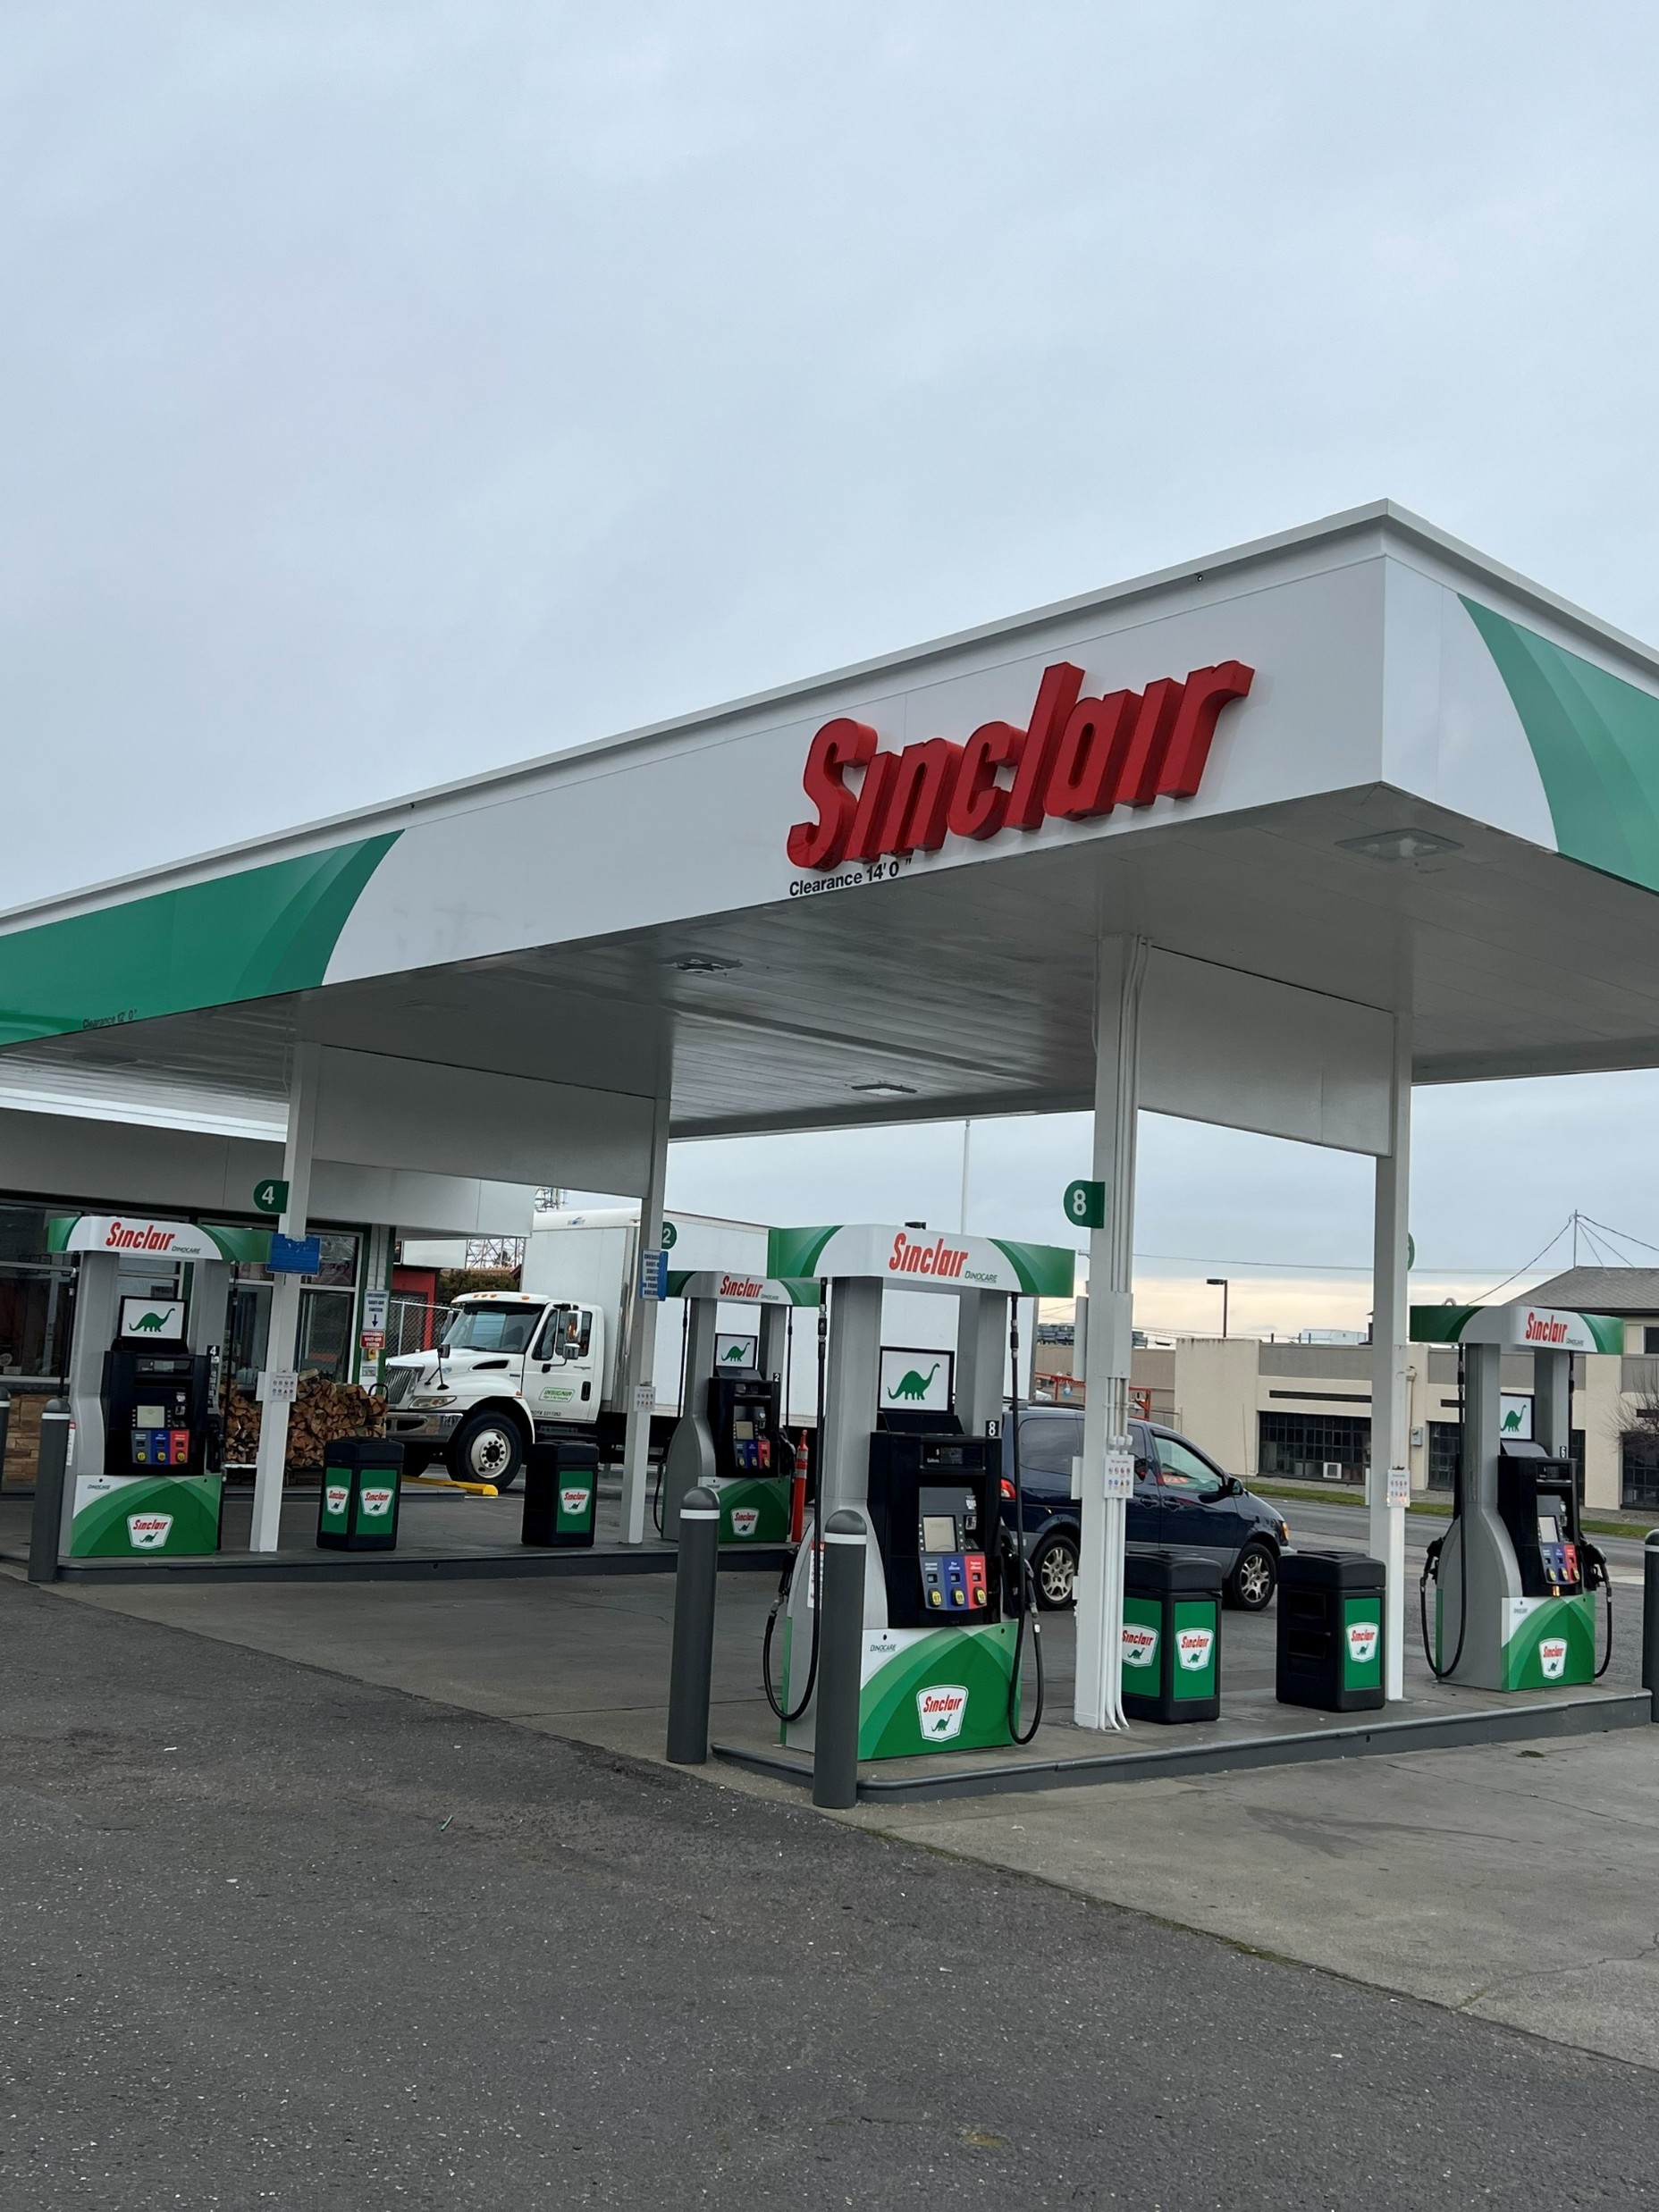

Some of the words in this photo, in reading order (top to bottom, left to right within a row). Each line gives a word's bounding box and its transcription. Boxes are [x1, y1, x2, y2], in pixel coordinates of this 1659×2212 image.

[787, 659, 1255, 871] Sinclair
[789, 871, 863, 896] Clearance
[82, 1016, 115, 1029] Clearance
[261, 1185, 274, 1205] 4
[1073, 1189, 1087, 1216] 8
[105, 1222, 175, 1250] Sinclair
[662, 1227, 671, 1243] 2
[888, 1232, 969, 1277] Sinclair
[964, 1270, 998, 1283] DINOCARE
[720, 1274, 762, 1298] Sinclair
[1525, 1311, 1568, 1343] Sinclair
[210, 1345, 216, 1356] 4
[774, 1374, 779, 1382] 2
[989, 1420, 996, 1436] 8
[1561, 1446, 1566, 1458] 6
[365, 1492, 390, 1501] Sinclair
[132, 1519, 168, 1531] Sinclair
[1123, 1630, 1154, 1646] Sinclair
[1182, 1636, 1209, 1649] Sinclair
[870, 1644, 897, 1653] DINOCARE
[923, 1695, 963, 1713] Sinclair
